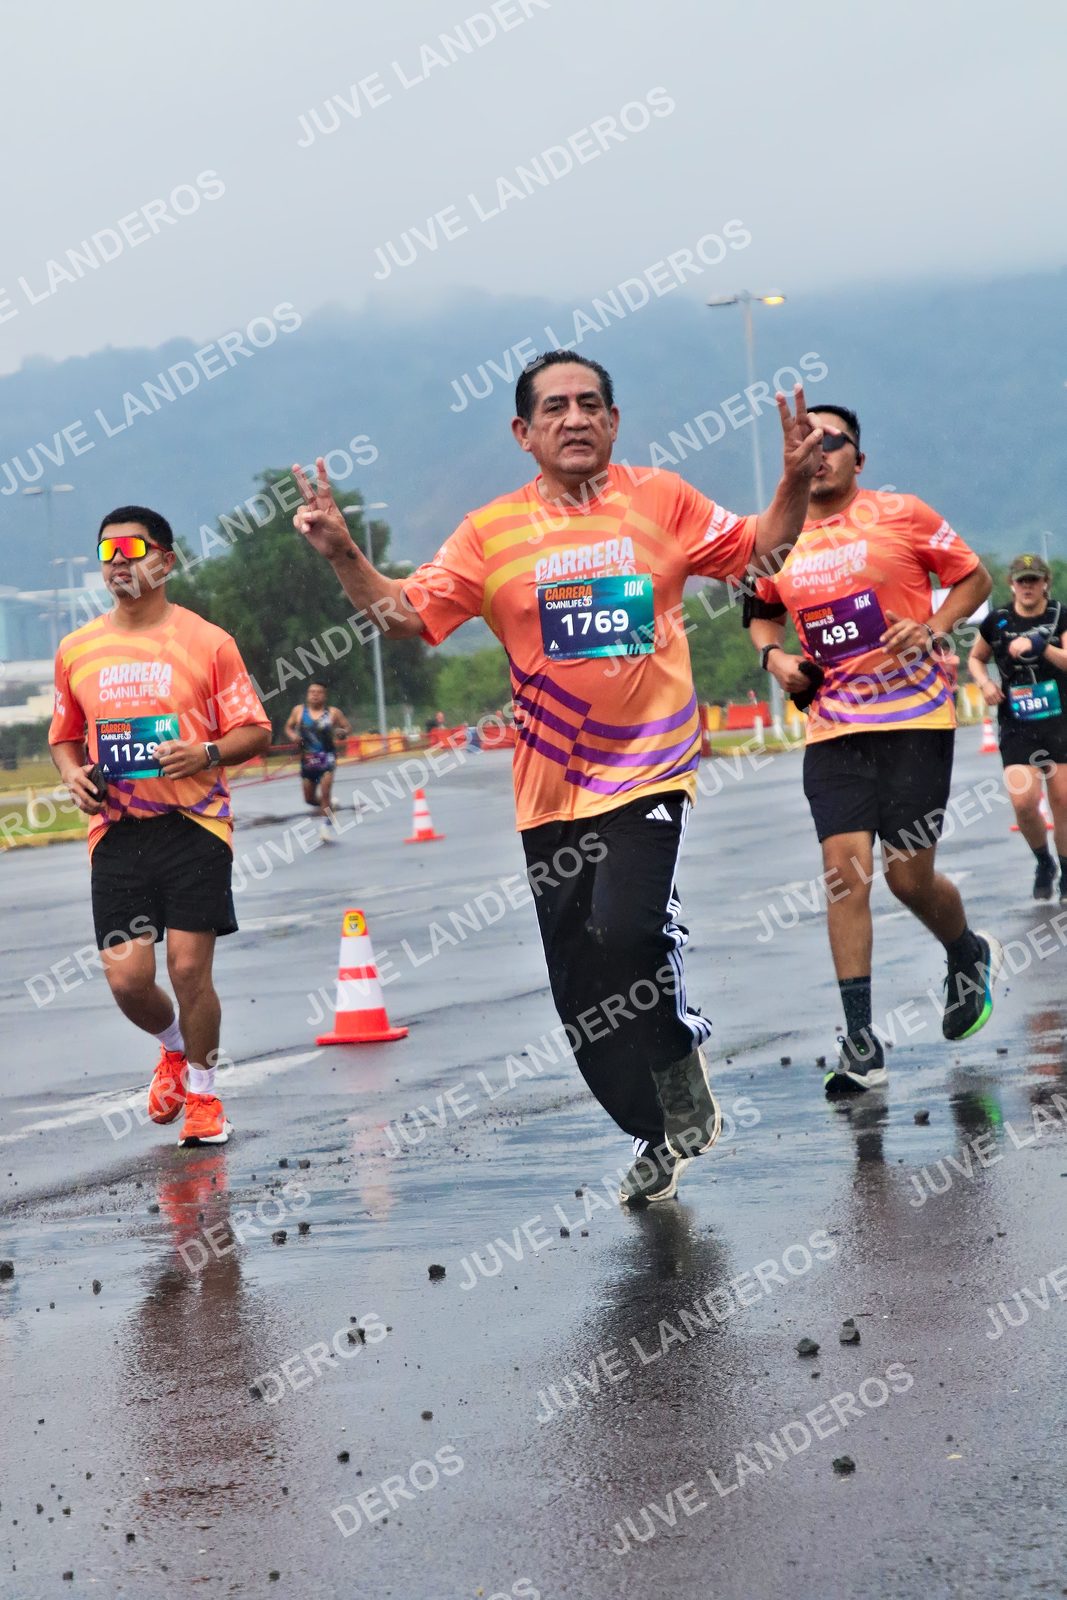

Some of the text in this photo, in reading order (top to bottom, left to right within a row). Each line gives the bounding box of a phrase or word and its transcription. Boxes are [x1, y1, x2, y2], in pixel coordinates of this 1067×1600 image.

[535, 536, 635, 582] CARRERA
[791, 540, 867, 576] CARRERA
[545, 585, 592, 601] CARRERA
[624, 581, 644, 597] 10K
[546, 599, 582, 610] OMNILIFE
[561, 609, 629, 636] 1769
[822, 621, 859, 645] 493
[99, 661, 172, 689] CARRERA
[99, 684, 155, 702] OMNILIFE
[155, 719, 171, 733] 10K
[110, 742, 158, 762] 1129
